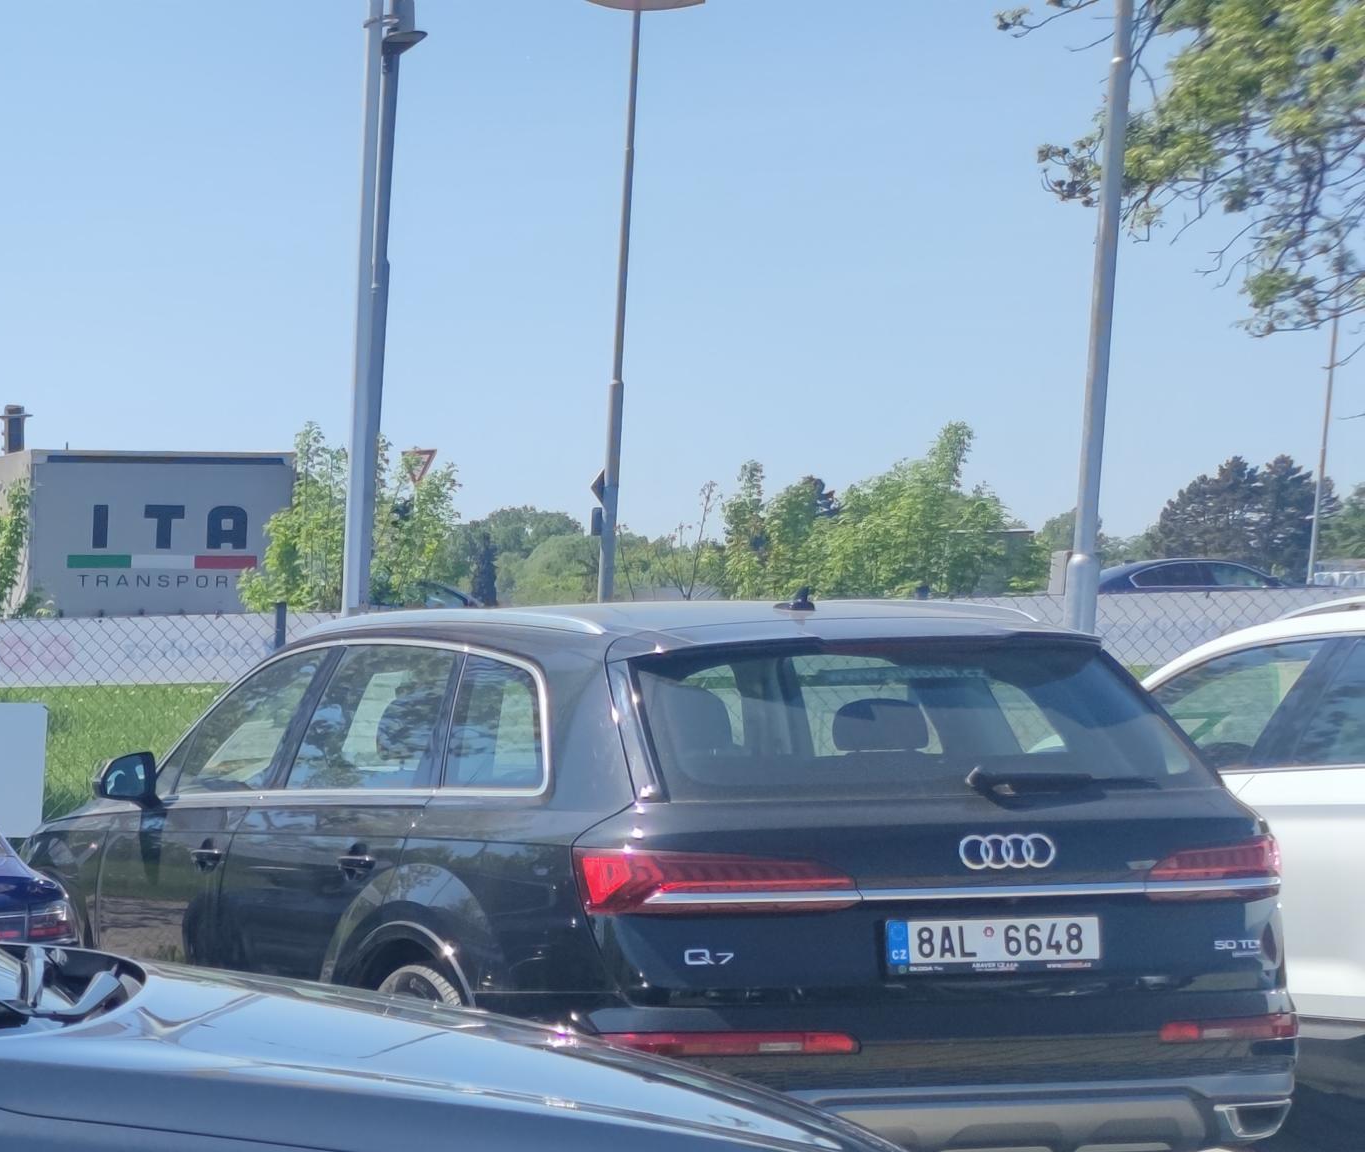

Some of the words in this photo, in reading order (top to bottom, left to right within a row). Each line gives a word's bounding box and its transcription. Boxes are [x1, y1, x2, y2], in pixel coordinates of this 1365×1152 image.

[92, 504, 248, 550] ITA
[77, 565, 243, 589] TRANSPOR
[891, 950, 908, 960] CZ
[917, 925, 977, 959] 8AL
[1004, 922, 1084, 957] 6648
